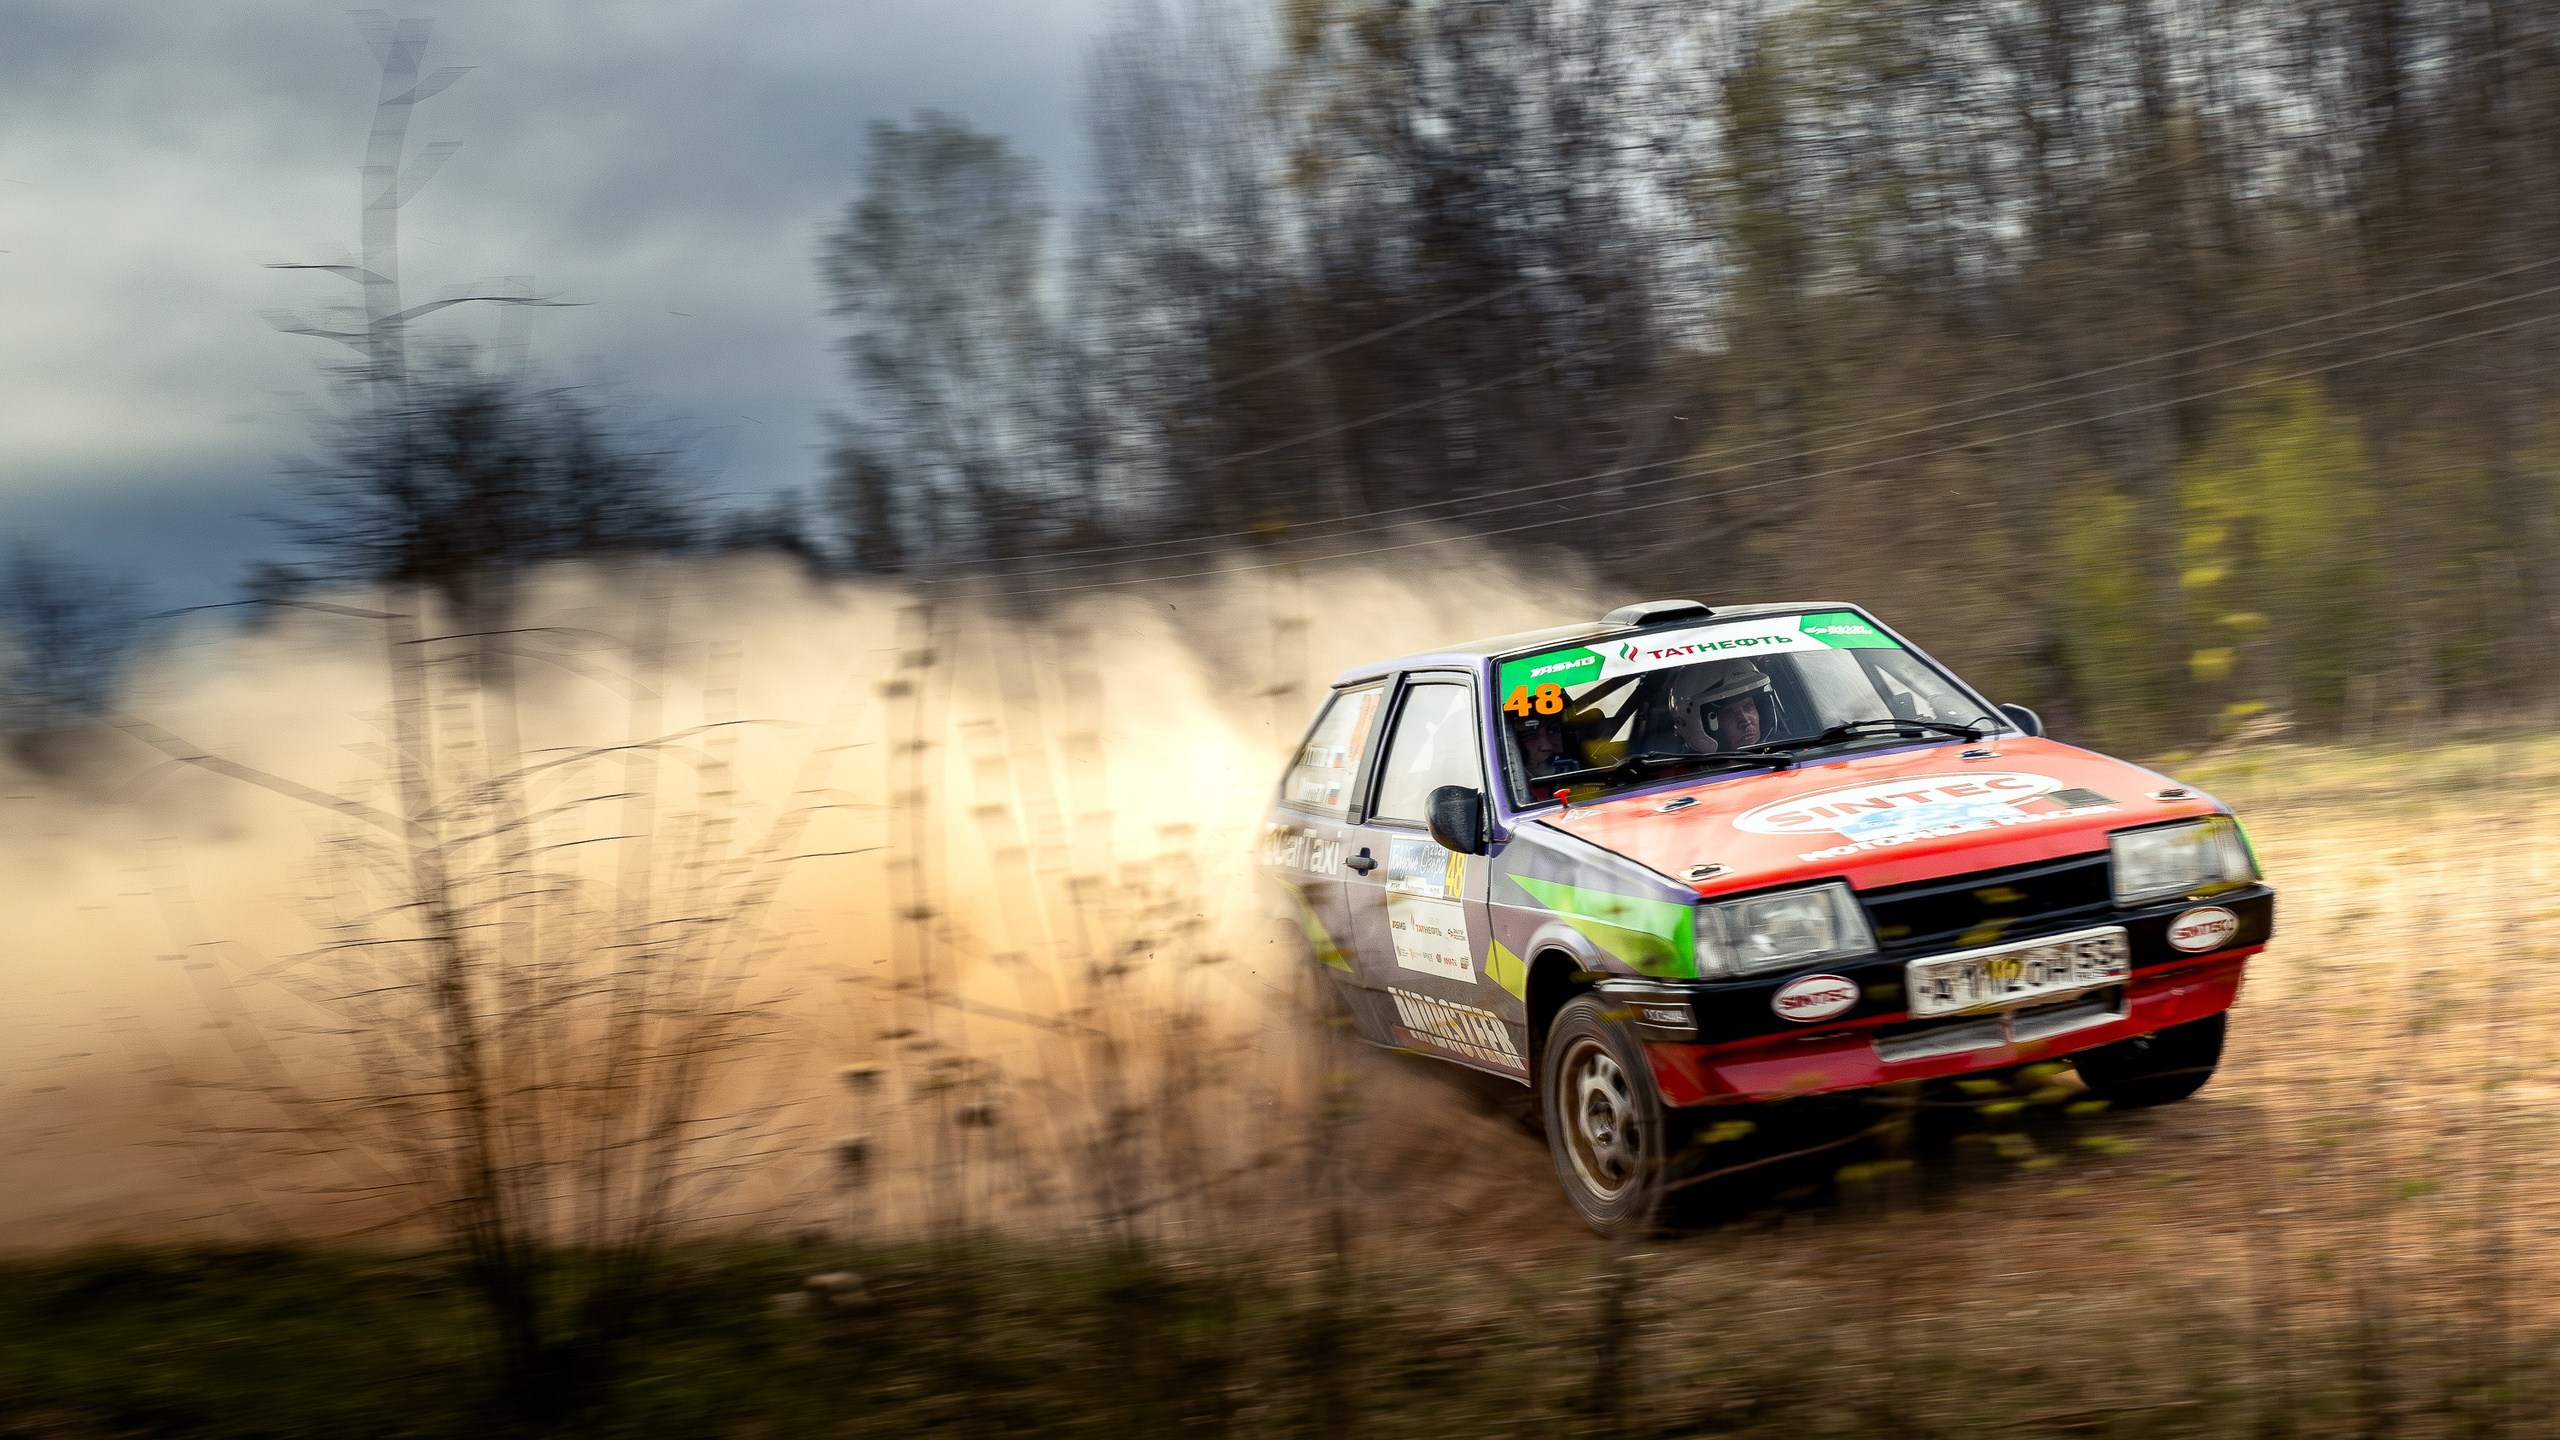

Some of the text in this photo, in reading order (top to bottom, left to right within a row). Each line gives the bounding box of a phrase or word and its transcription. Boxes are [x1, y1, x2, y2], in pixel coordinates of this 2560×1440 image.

[1646, 635, 1794, 660] ТАТНЕФТЬ
[1502, 682, 1564, 717] 48
[1766, 776, 2035, 828] SINTEC
[1445, 851, 1466, 898] 48
